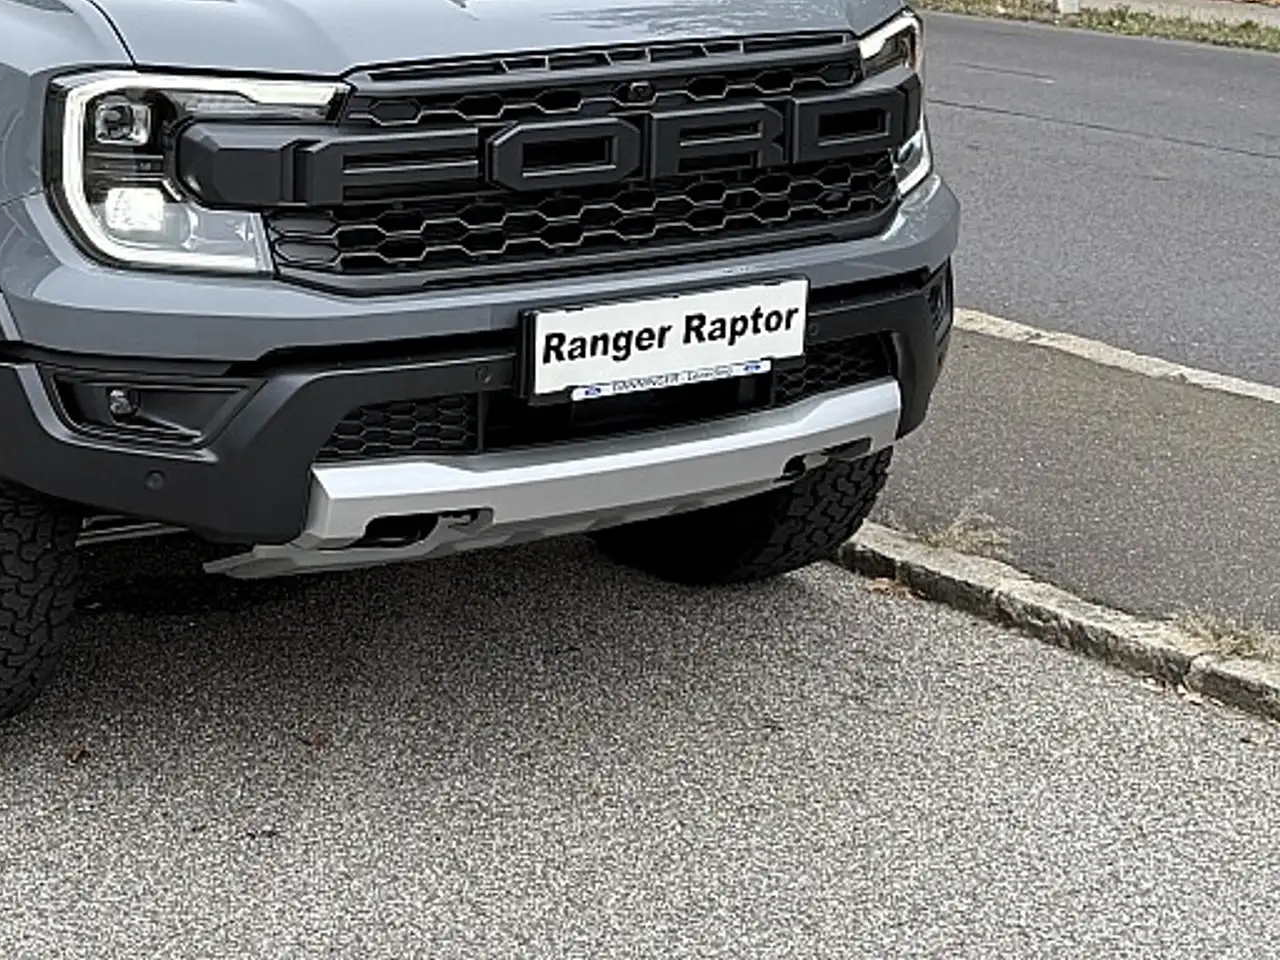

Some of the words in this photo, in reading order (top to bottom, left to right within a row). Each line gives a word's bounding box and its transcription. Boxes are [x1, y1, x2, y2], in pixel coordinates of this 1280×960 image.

[294, 84, 910, 204] FORD
[542, 324, 673, 364] Ranger
[682, 305, 799, 346] Raptor
